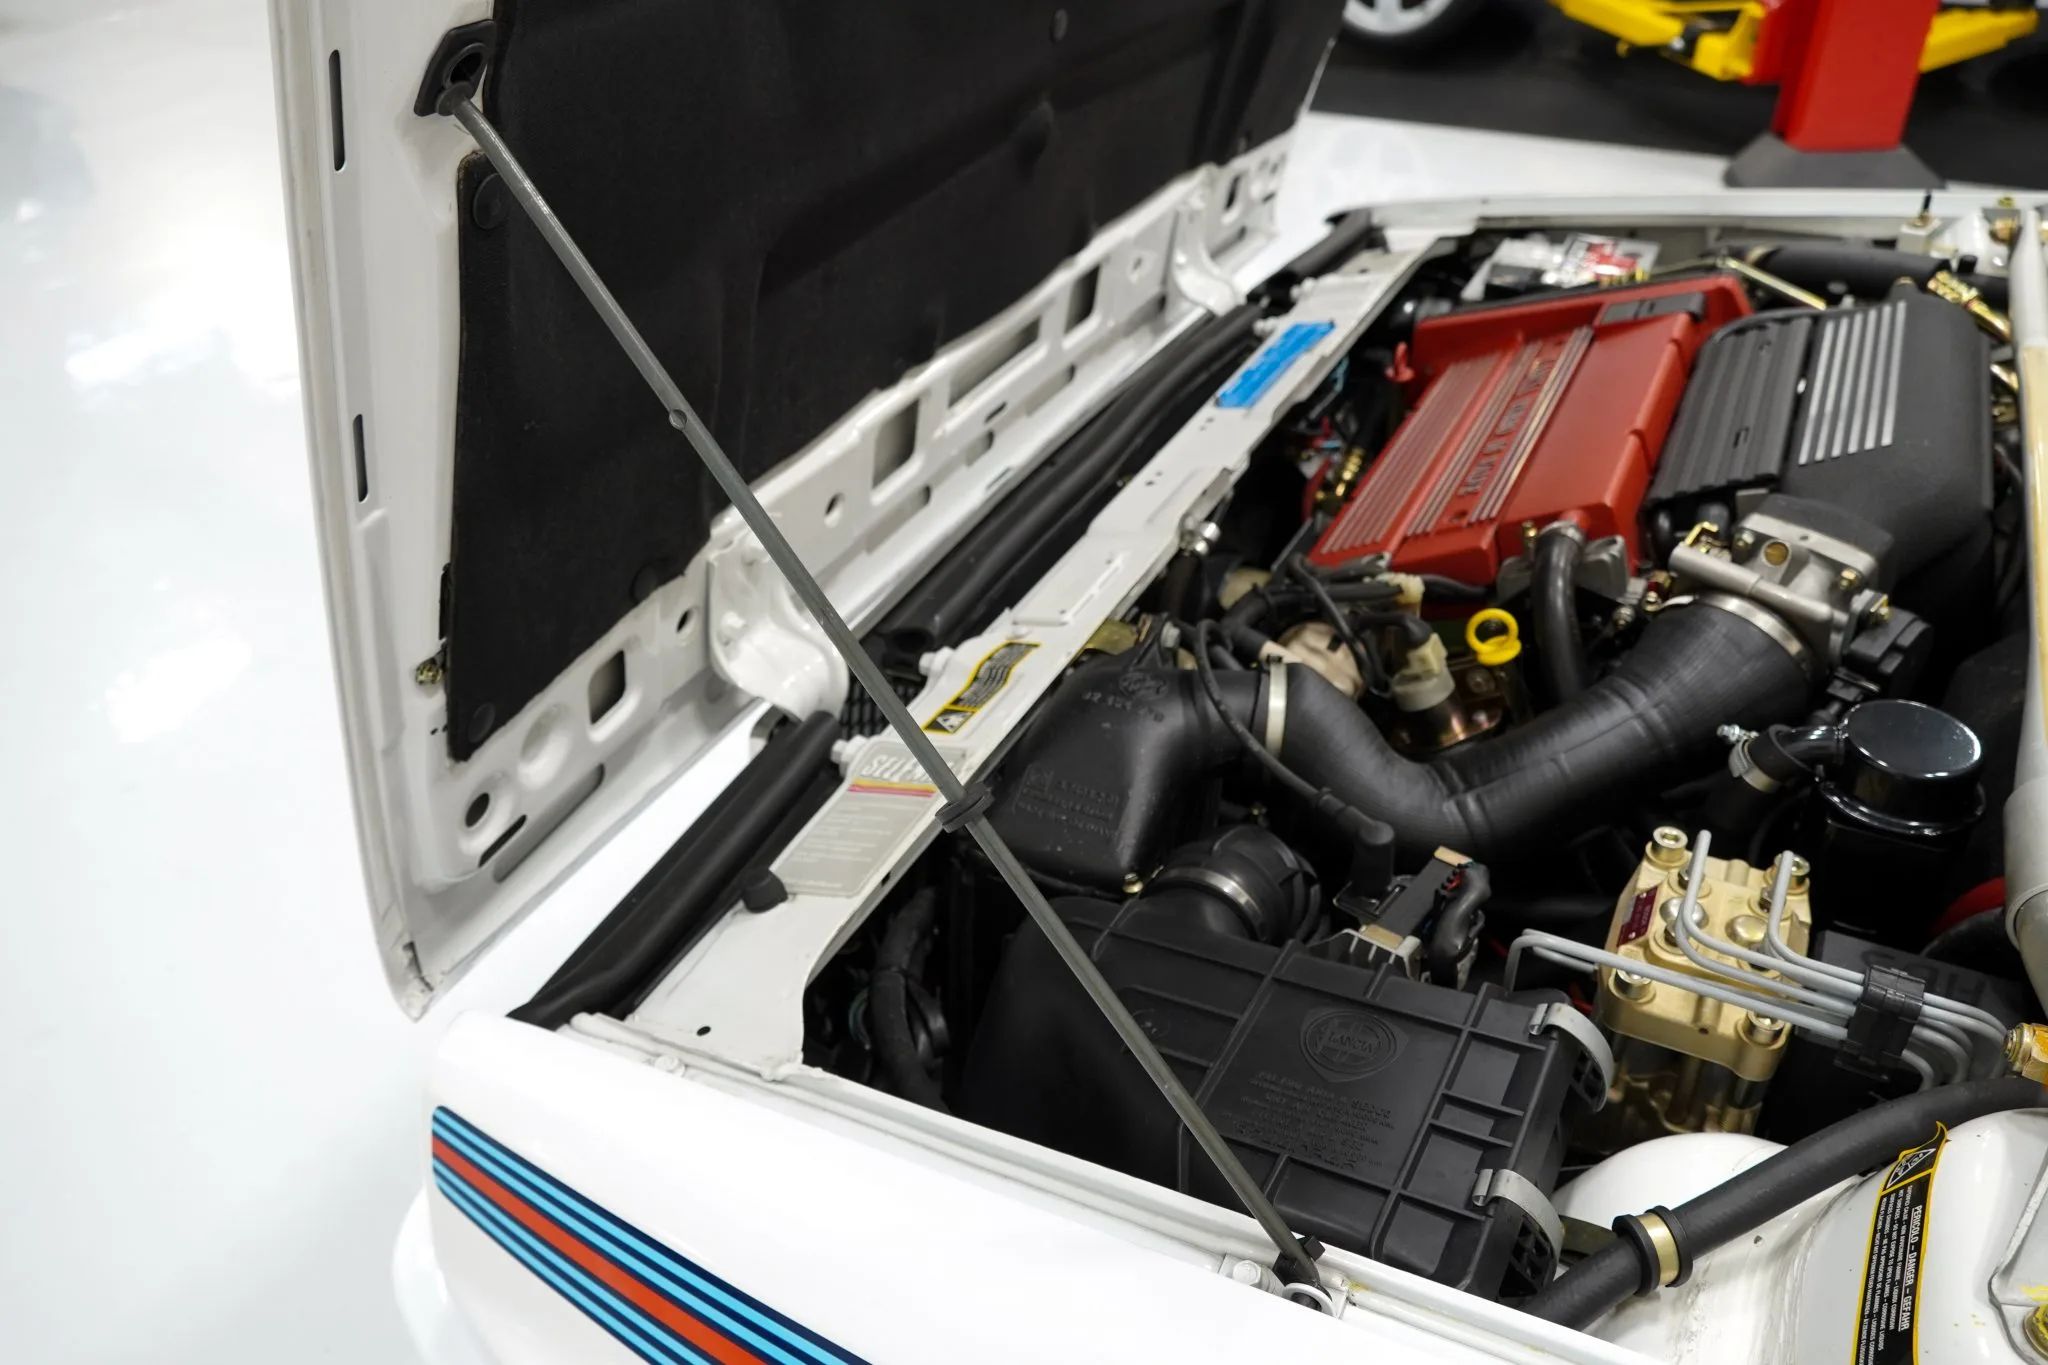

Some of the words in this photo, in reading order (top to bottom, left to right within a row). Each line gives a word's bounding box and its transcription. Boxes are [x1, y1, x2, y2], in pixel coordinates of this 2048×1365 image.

[1327, 1031, 1378, 1054] LANCIA
[1910, 1205, 1922, 1243] PERICOLO
[1905, 1252, 1917, 1286] DANGER
[1900, 1296, 1912, 1330] GEFAHR
